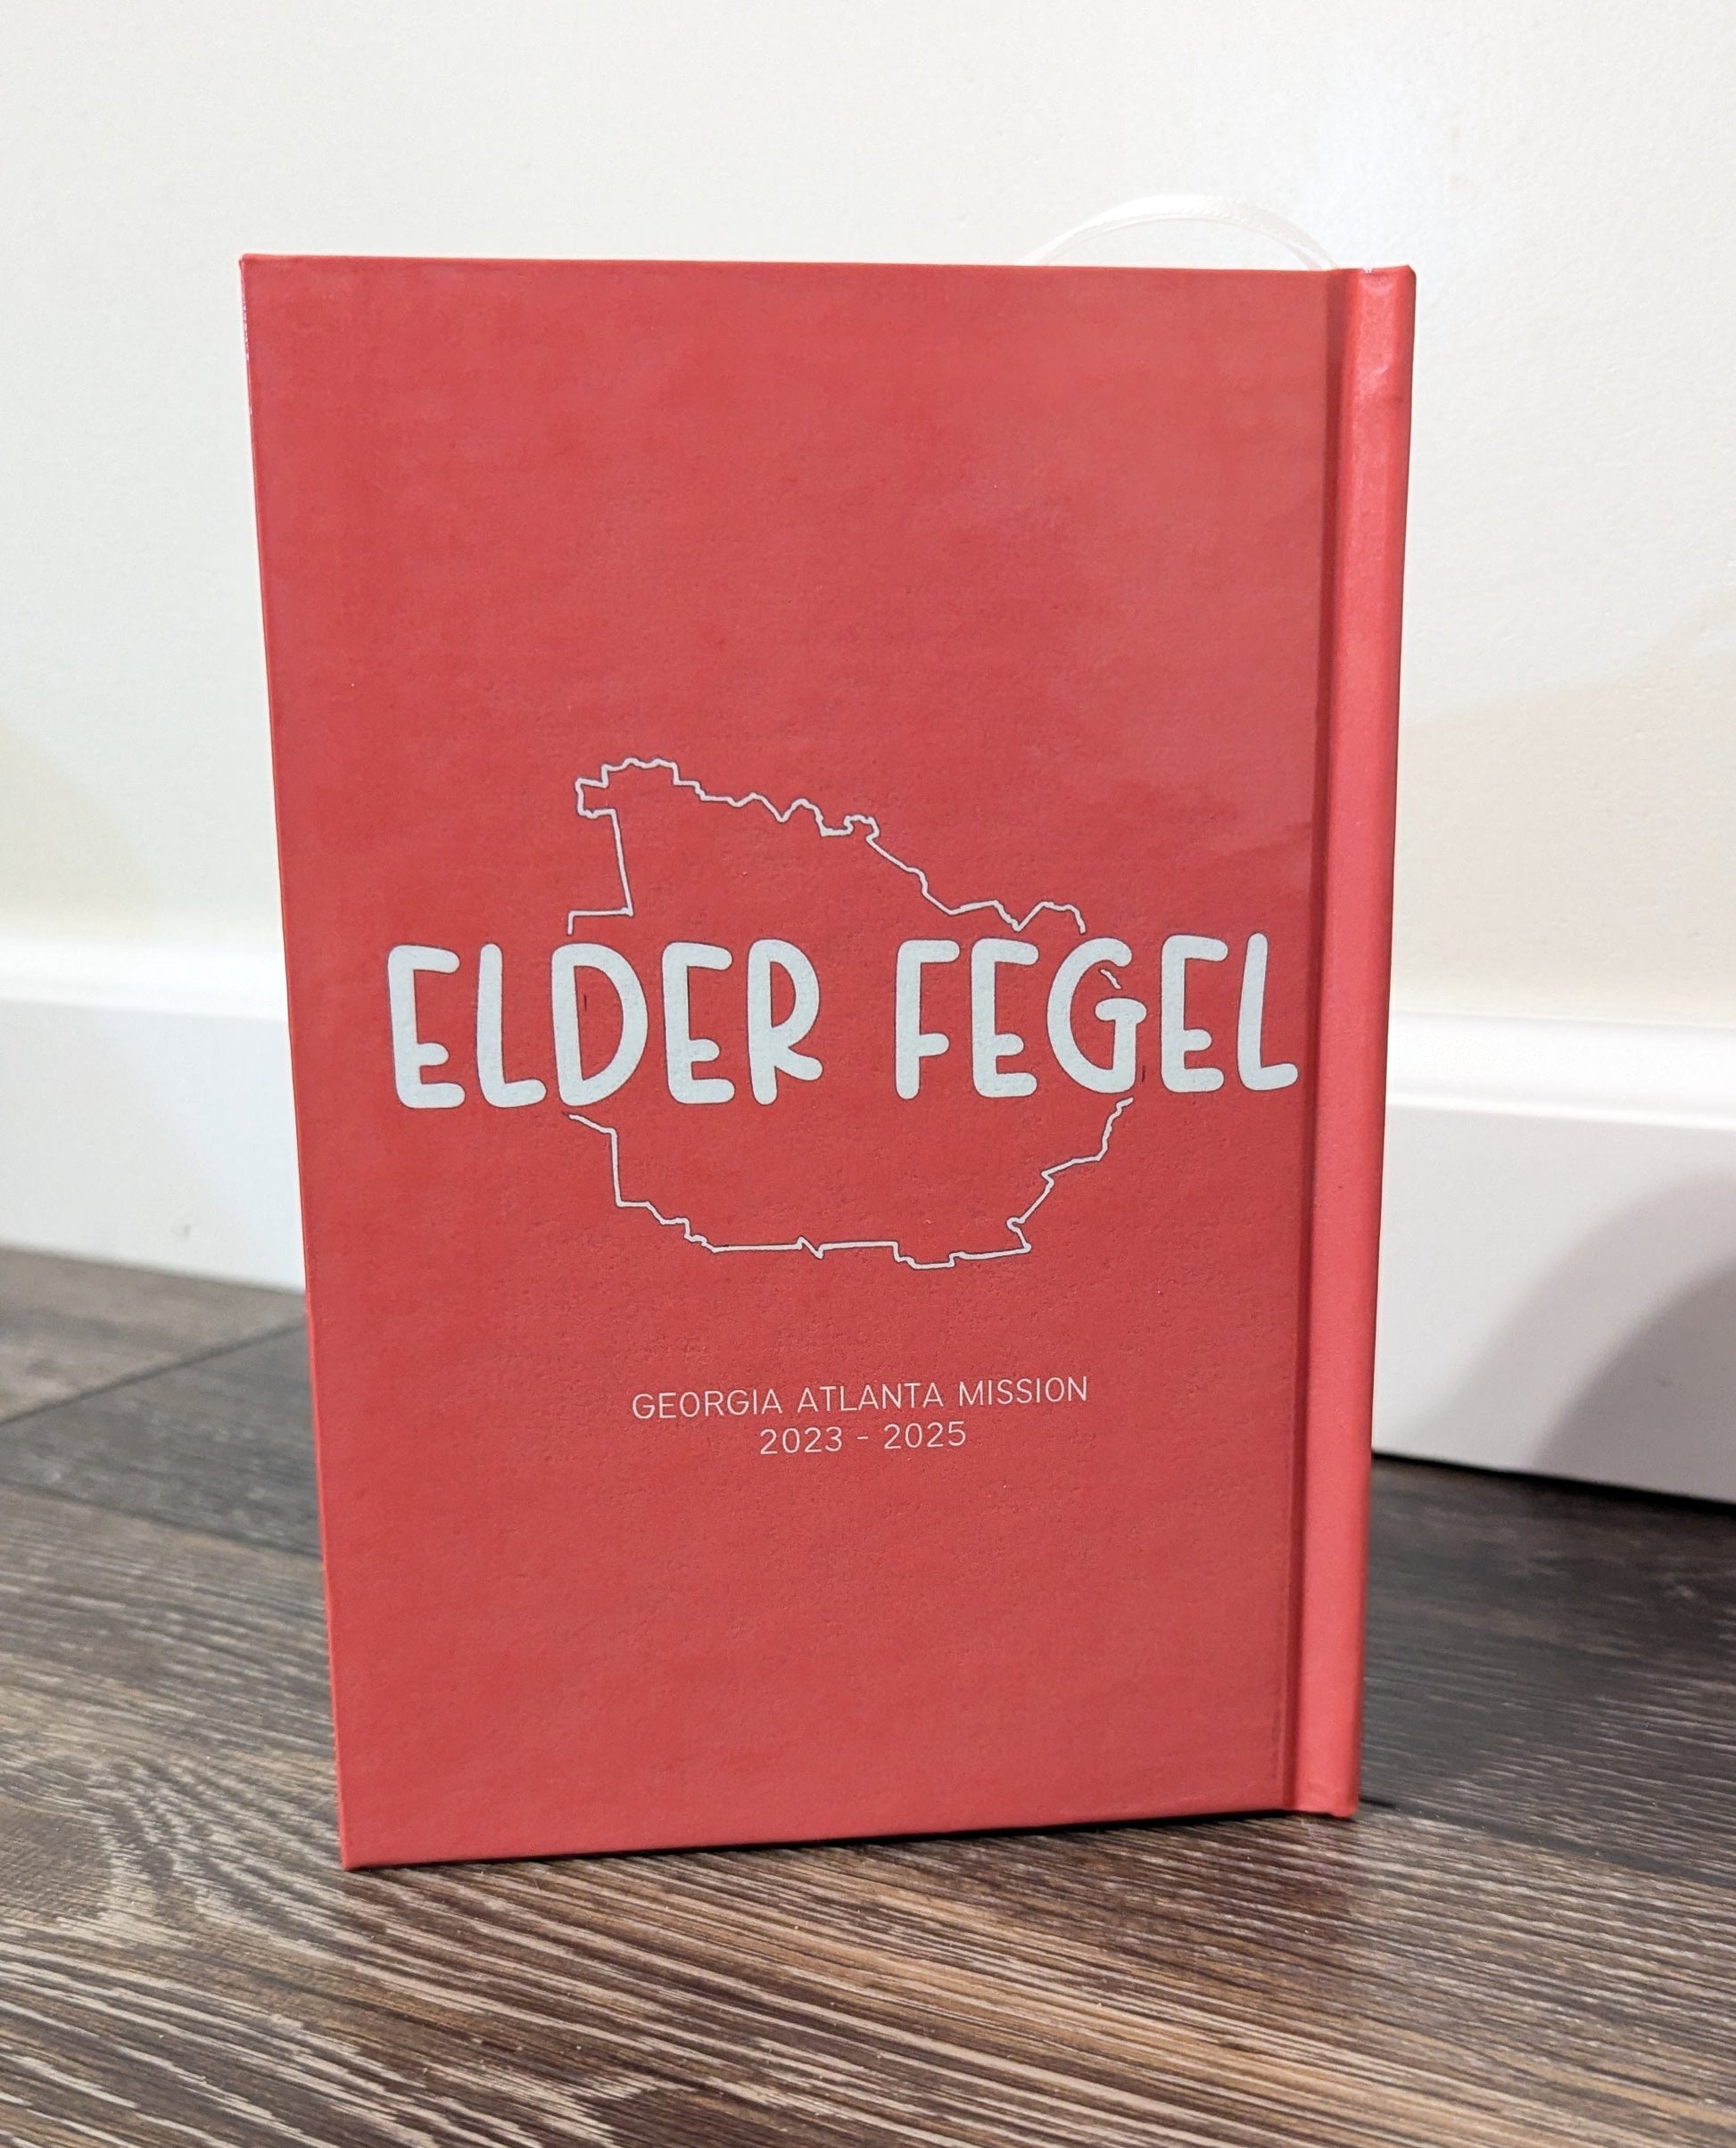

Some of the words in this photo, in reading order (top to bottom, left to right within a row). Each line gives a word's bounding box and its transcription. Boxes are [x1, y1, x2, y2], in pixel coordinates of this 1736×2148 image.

[387, 938, 823, 1109] ELDER
[895, 932, 1299, 1100] FEGEL
[632, 1388, 783, 1419] GEORGIA
[797, 1382, 945, 1413] ATLANTA
[959, 1376, 1087, 1407] MISSION
[760, 1425, 843, 1455] 2023
[883, 1420, 966, 1450] 2025
